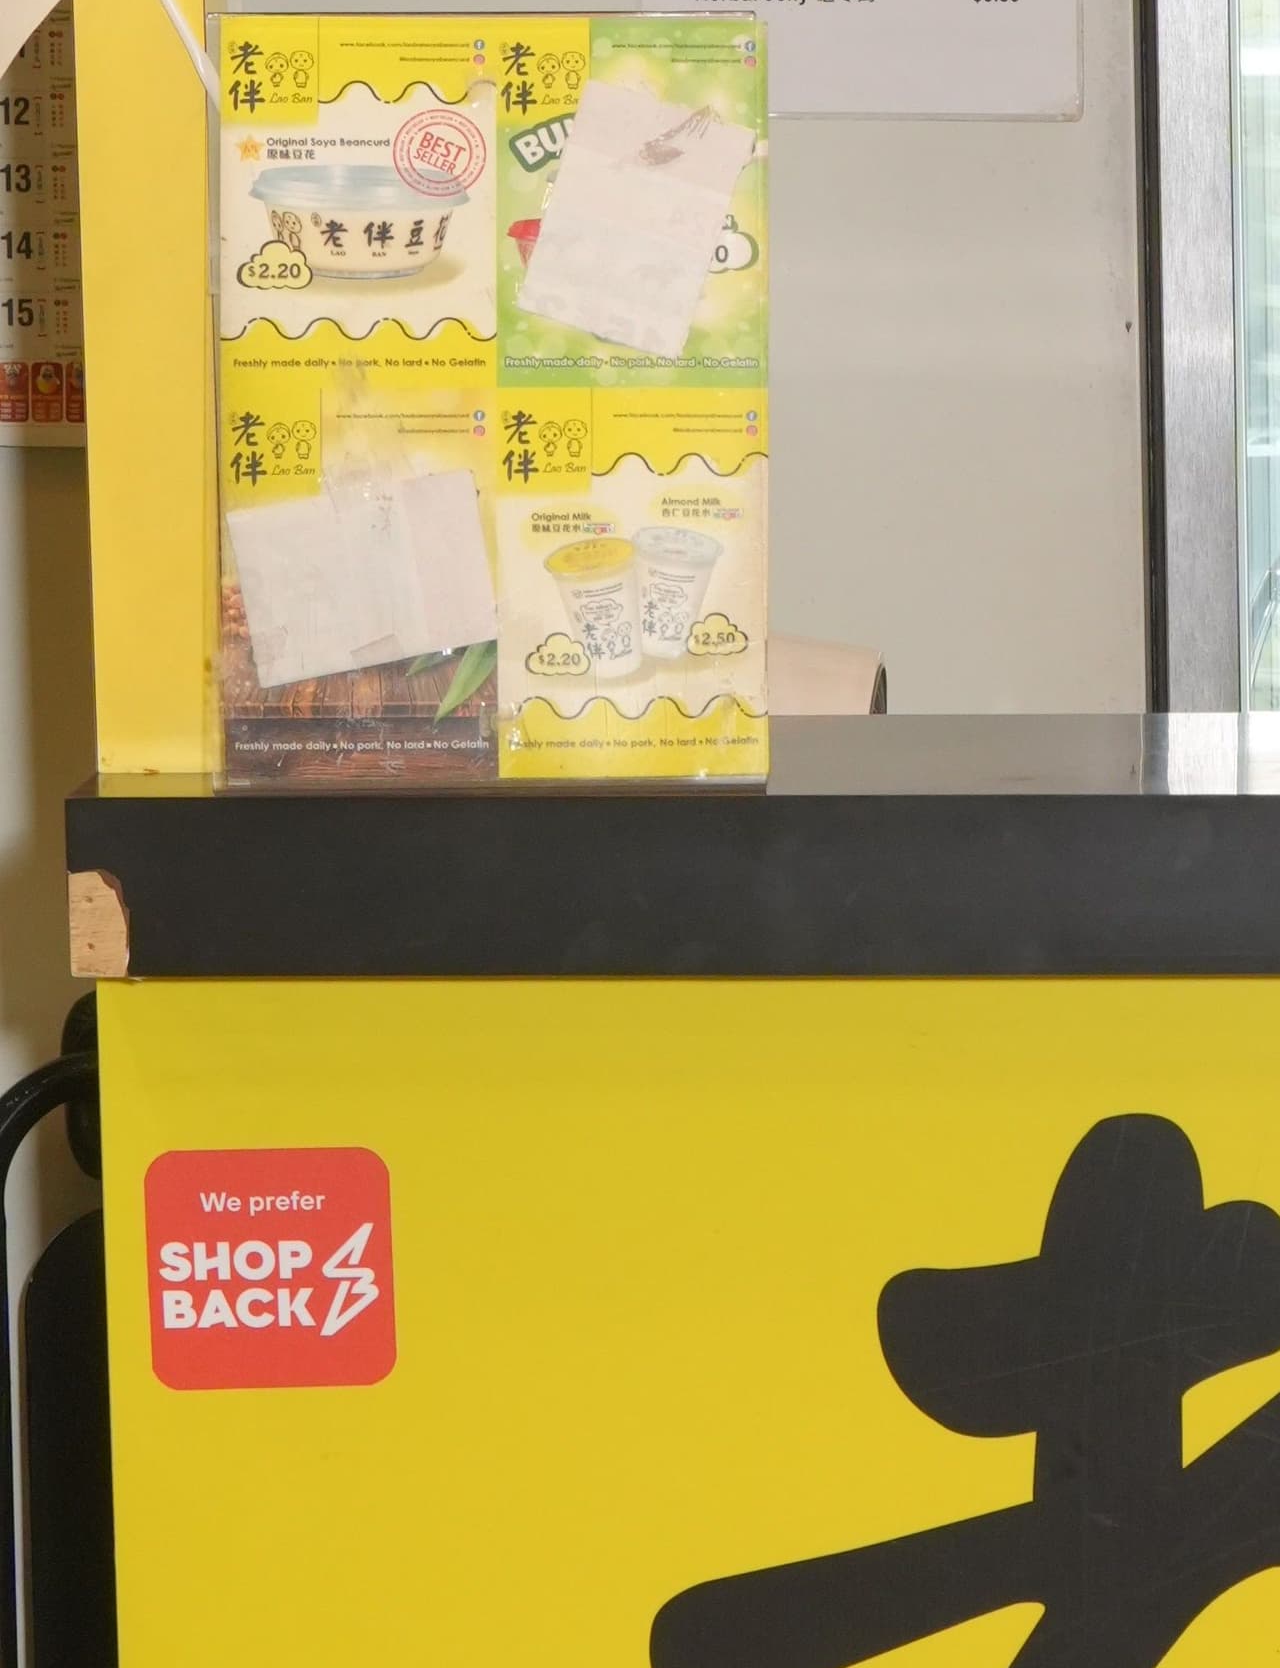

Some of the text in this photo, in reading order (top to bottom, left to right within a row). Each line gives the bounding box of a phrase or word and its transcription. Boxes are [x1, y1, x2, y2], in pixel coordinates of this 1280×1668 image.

[228, 40, 266, 114] 老伴
[0, 95, 31, 126] 12
[269, 92, 313, 104] Lao Ban
[266, 137, 391, 149] Original Soya Beancurd
[419, 131, 466, 163] BEST
[413, 148, 457, 174] SELLER
[1, 163, 32, 194] 13
[1, 231, 34, 260] 14
[247, 263, 301, 280] $2.20
[1, 298, 34, 327] 15
[233, 358, 486, 369] Freshly made daily No lard No Gelatin
[661, 497, 721, 507] Almond Milk
[531, 512, 592, 523] Original Milk
[538, 652, 581, 667] $2.20
[199, 1190, 326, 1217] We prefer
[158, 1239, 313, 1283] SHOP
[161, 1287, 317, 1330] BACK
